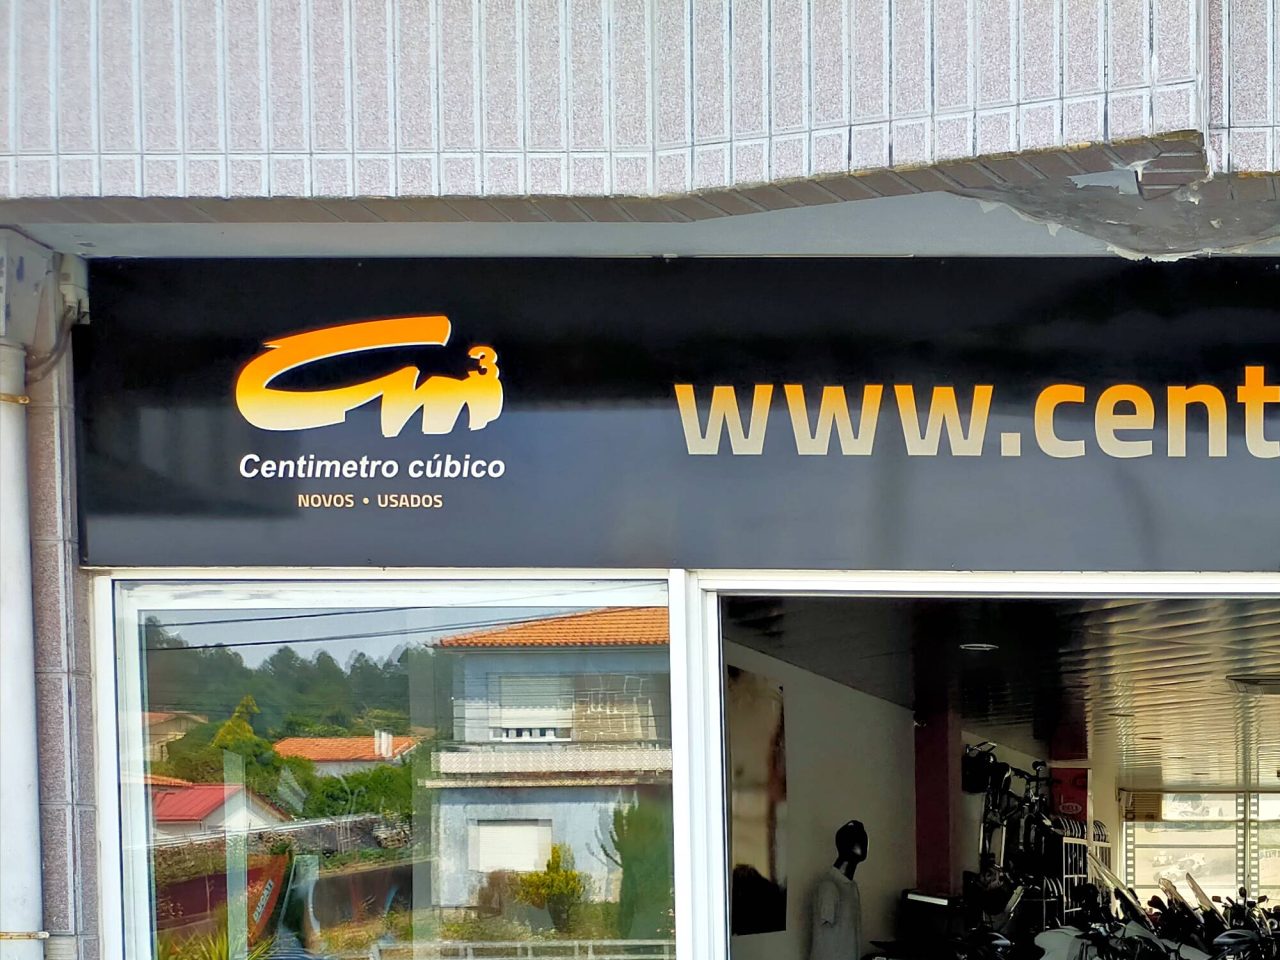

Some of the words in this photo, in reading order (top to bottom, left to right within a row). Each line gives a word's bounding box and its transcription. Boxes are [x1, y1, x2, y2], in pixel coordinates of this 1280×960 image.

[239, 453, 399, 479] Centimetro
[408, 453, 506, 479] cúbico
[297, 493, 355, 508] NOVOS
[377, 493, 443, 508] USADOS
